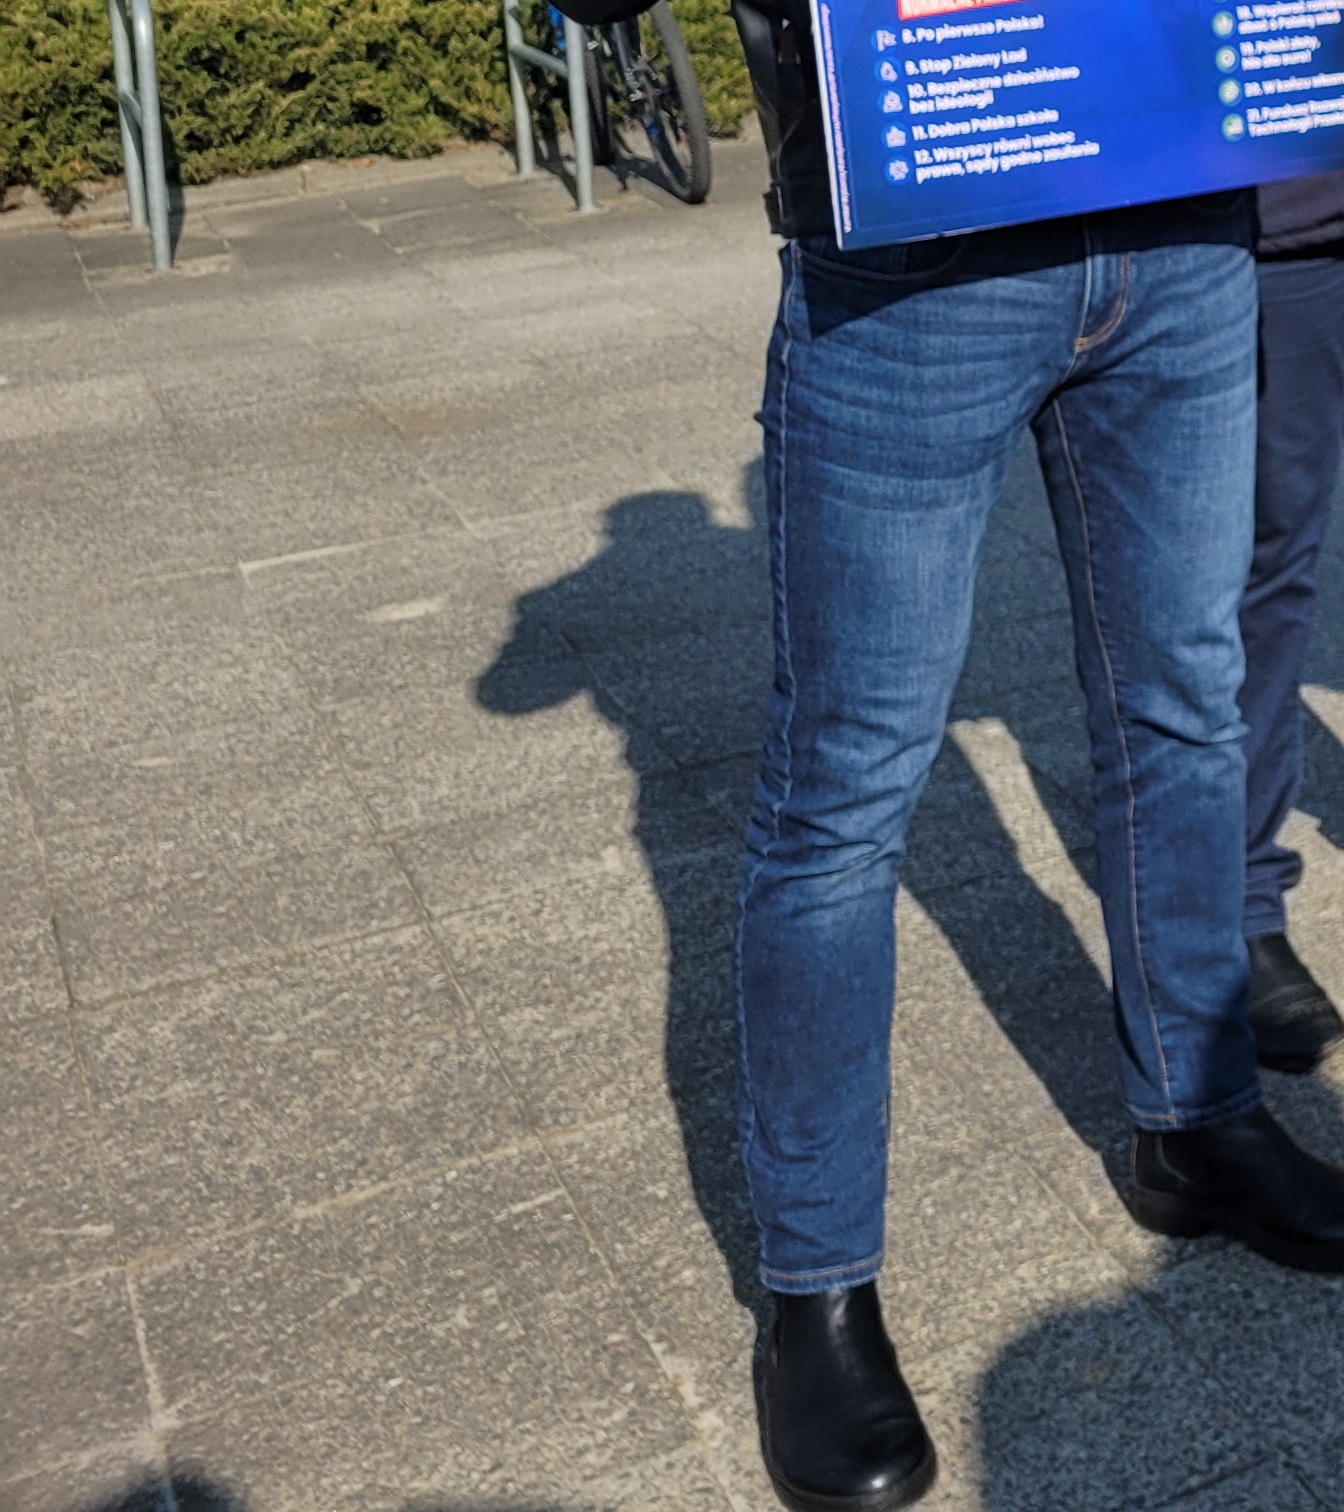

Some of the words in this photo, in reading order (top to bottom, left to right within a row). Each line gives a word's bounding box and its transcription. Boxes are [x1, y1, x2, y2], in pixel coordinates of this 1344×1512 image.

[916, 27, 935, 42] Po
[936, 21, 995, 44] pierwsze
[919, 57, 952, 75] Stop
[927, 76, 1002, 97] Bezpieczne
[928, 121, 971, 139] Dobra
[971, 114, 1016, 133] Polska
[933, 142, 993, 162] Wszyscy
